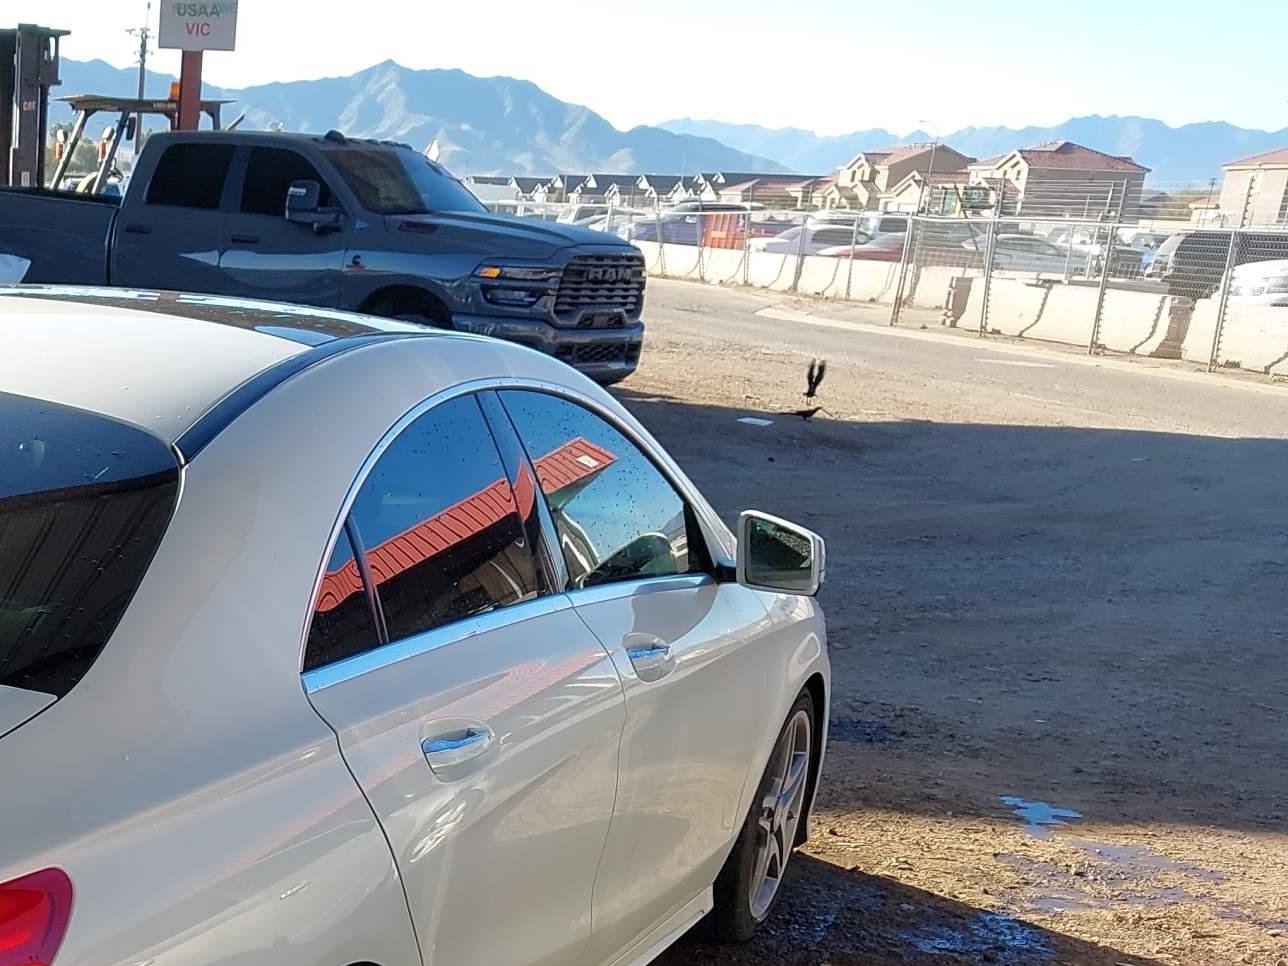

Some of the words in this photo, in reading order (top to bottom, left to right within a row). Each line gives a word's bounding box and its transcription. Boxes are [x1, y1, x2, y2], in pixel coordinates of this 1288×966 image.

[177, 3, 220, 17] USAA
[185, 22, 211, 36] VIC
[588, 267, 632, 281] RAM
